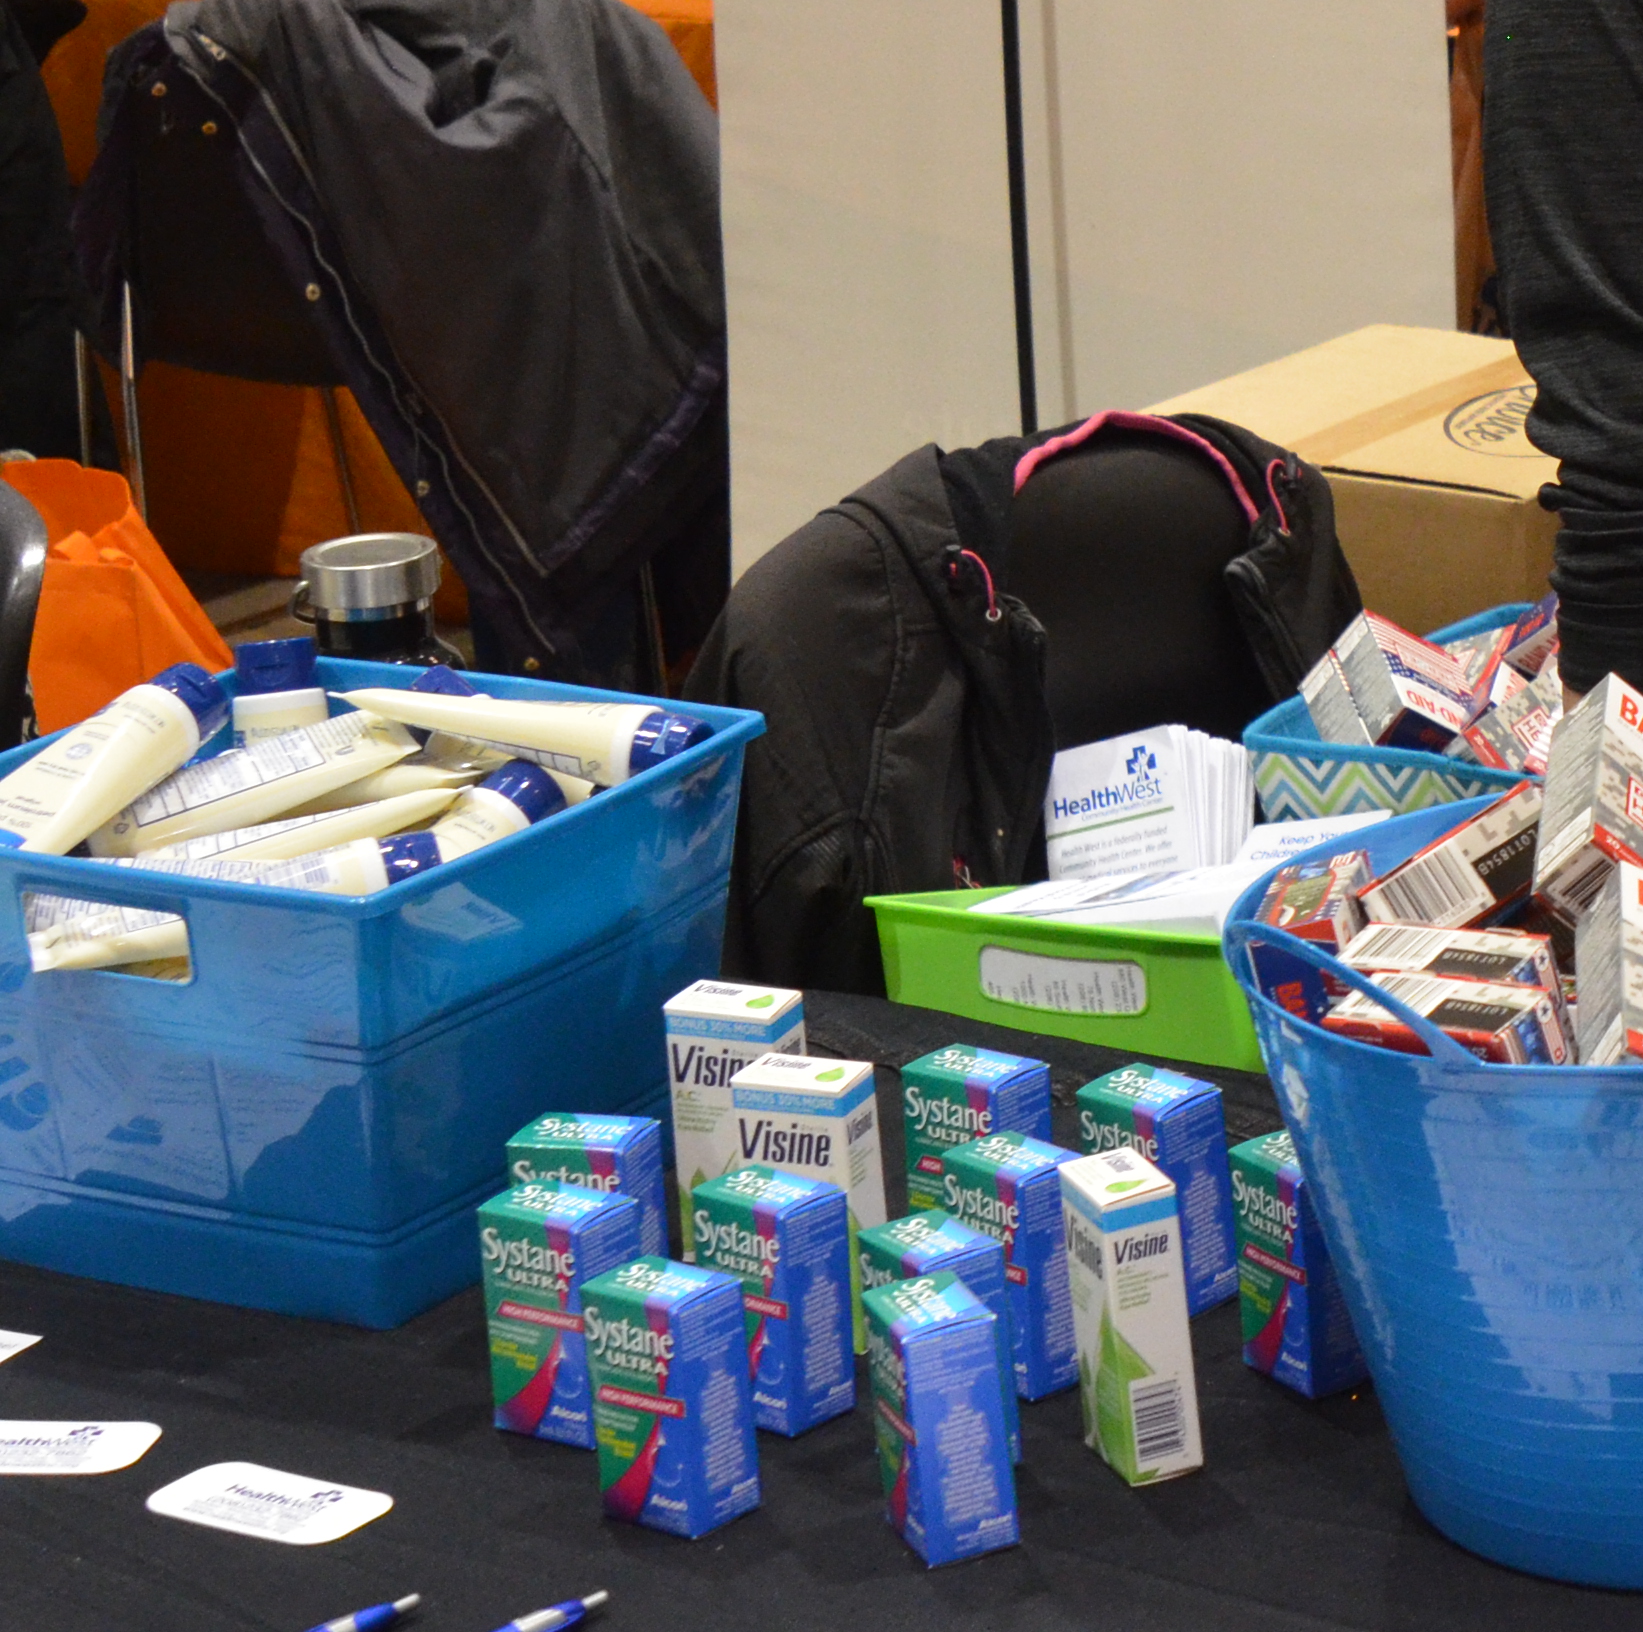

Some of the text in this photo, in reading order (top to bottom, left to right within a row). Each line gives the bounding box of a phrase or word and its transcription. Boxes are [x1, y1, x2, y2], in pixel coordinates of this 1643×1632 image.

[1053, 778, 1163, 820] HealthWest
[1279, 834, 1315, 847] Keep
[1606, 834, 1620, 851] 20
[694, 984, 743, 996] Visine
[672, 1043, 755, 1088] Visin
[762, 1057, 811, 1069] Visine
[933, 1049, 1021, 1074] Systane
[1109, 1069, 1189, 1099] Systane
[1116, 1084, 1164, 1105] ULTRA
[905, 1086, 992, 1133] Systane
[534, 1118, 635, 1135] Systane
[739, 1118, 831, 1167] Visine
[975, 1136, 1055, 1167] Systane
[511, 1185, 609, 1209] Systane
[727, 1171, 813, 1198] Systane
[944, 1174, 1020, 1229] Systane
[1232, 1169, 1298, 1230] Systane
[694, 1210, 781, 1263] Systane
[1248, 1212, 1294, 1244] ULTRA
[481, 1227, 577, 1278] Systane
[1113, 1233, 1169, 1264] Visine
[616, 1263, 707, 1290] Systane
[715, 1252, 774, 1279] ULTRA
[506, 1268, 570, 1293] ULTRA
[584, 1306, 675, 1360] Systane
[605, 1349, 669, 1376] ULTRA
